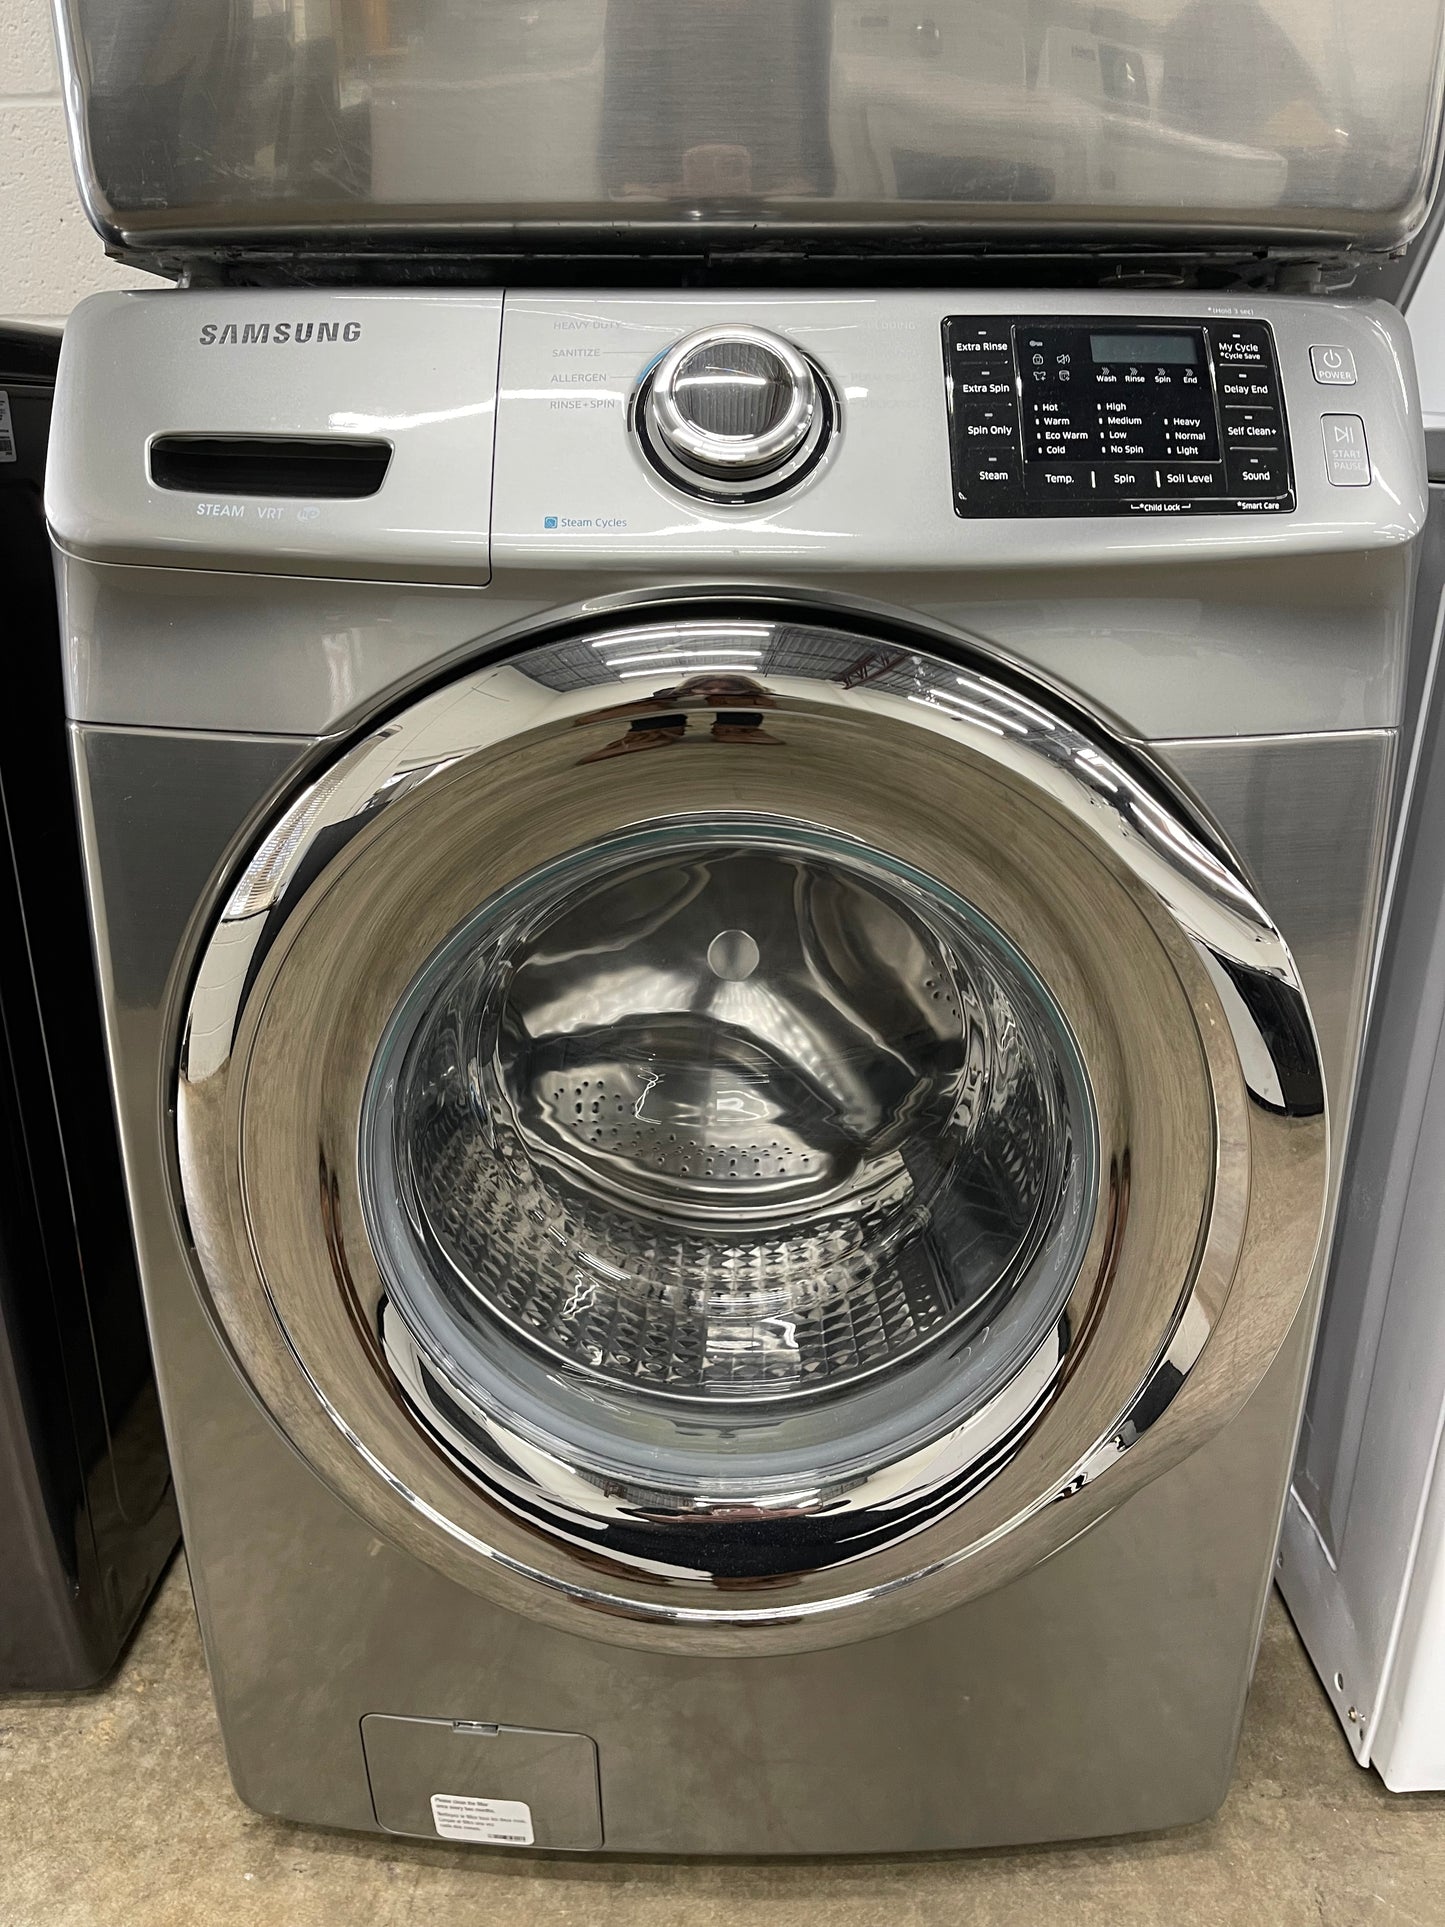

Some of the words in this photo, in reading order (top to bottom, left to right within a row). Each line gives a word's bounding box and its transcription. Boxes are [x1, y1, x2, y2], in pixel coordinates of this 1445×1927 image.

[553, 321, 590, 330] HEAVY
[593, 320, 621, 330] DUTY
[199, 322, 361, 345] SAMSUNG
[956, 342, 981, 352] Extra
[983, 342, 1008, 351] Rinse
[1219, 342, 1233, 352] My
[1234, 343, 1259, 352] Cycle
[552, 349, 600, 357] SANITIZE
[551, 373, 607, 383] ALLERGEN
[1096, 375, 1117, 383] Wash
[1125, 375, 1146, 383] Rinse
[1155, 375, 1171, 384] Spin
[1183, 376, 1198, 384] End
[1318, 370, 1351, 379] POWER
[963, 384, 988, 393] Extra
[989, 383, 1010, 394] Spin
[1224, 384, 1249, 395] Delay
[1251, 385, 1268, 394] End
[550, 400, 581, 409] RINSE
[591, 399, 615, 408] SPIN
[1042, 403, 1058, 412] Hot
[1106, 402, 1127, 412] High
[1043, 417, 1070, 426] Warm
[1107, 416, 1142, 425] Medium
[1173, 417, 1201, 427] Heavy
[967, 425, 988, 436] Spin
[990, 425, 1012, 436] Only
[1109, 431, 1127, 439] Low
[1227, 426, 1245, 436] Self
[1045, 432, 1061, 440] Eco
[1062, 432, 1088, 440] Warm
[1174, 432, 1206, 441] Normal
[1046, 446, 1066, 454] Cold
[1110, 446, 1123, 454] No
[1124, 445, 1144, 455] Spin
[1176, 446, 1199, 455] Light
[1332, 450, 1362, 459] START
[1334, 461, 1362, 470] PAUSE
[979, 471, 1009, 480] Steam
[1045, 474, 1075, 484] Temp.
[1113, 473, 1136, 484] Spin
[1167, 473, 1185, 483] Soil
[1187, 473, 1213, 483] Level
[1242, 471, 1271, 481] Sound
[196, 503, 245, 517] STEAM
[257, 507, 285, 519] VRT
[1163, 503, 1181, 511] Lock
[1263, 502, 1280, 510] Care
[561, 518, 593, 528] Steam
[595, 518, 627, 529] Cycles
